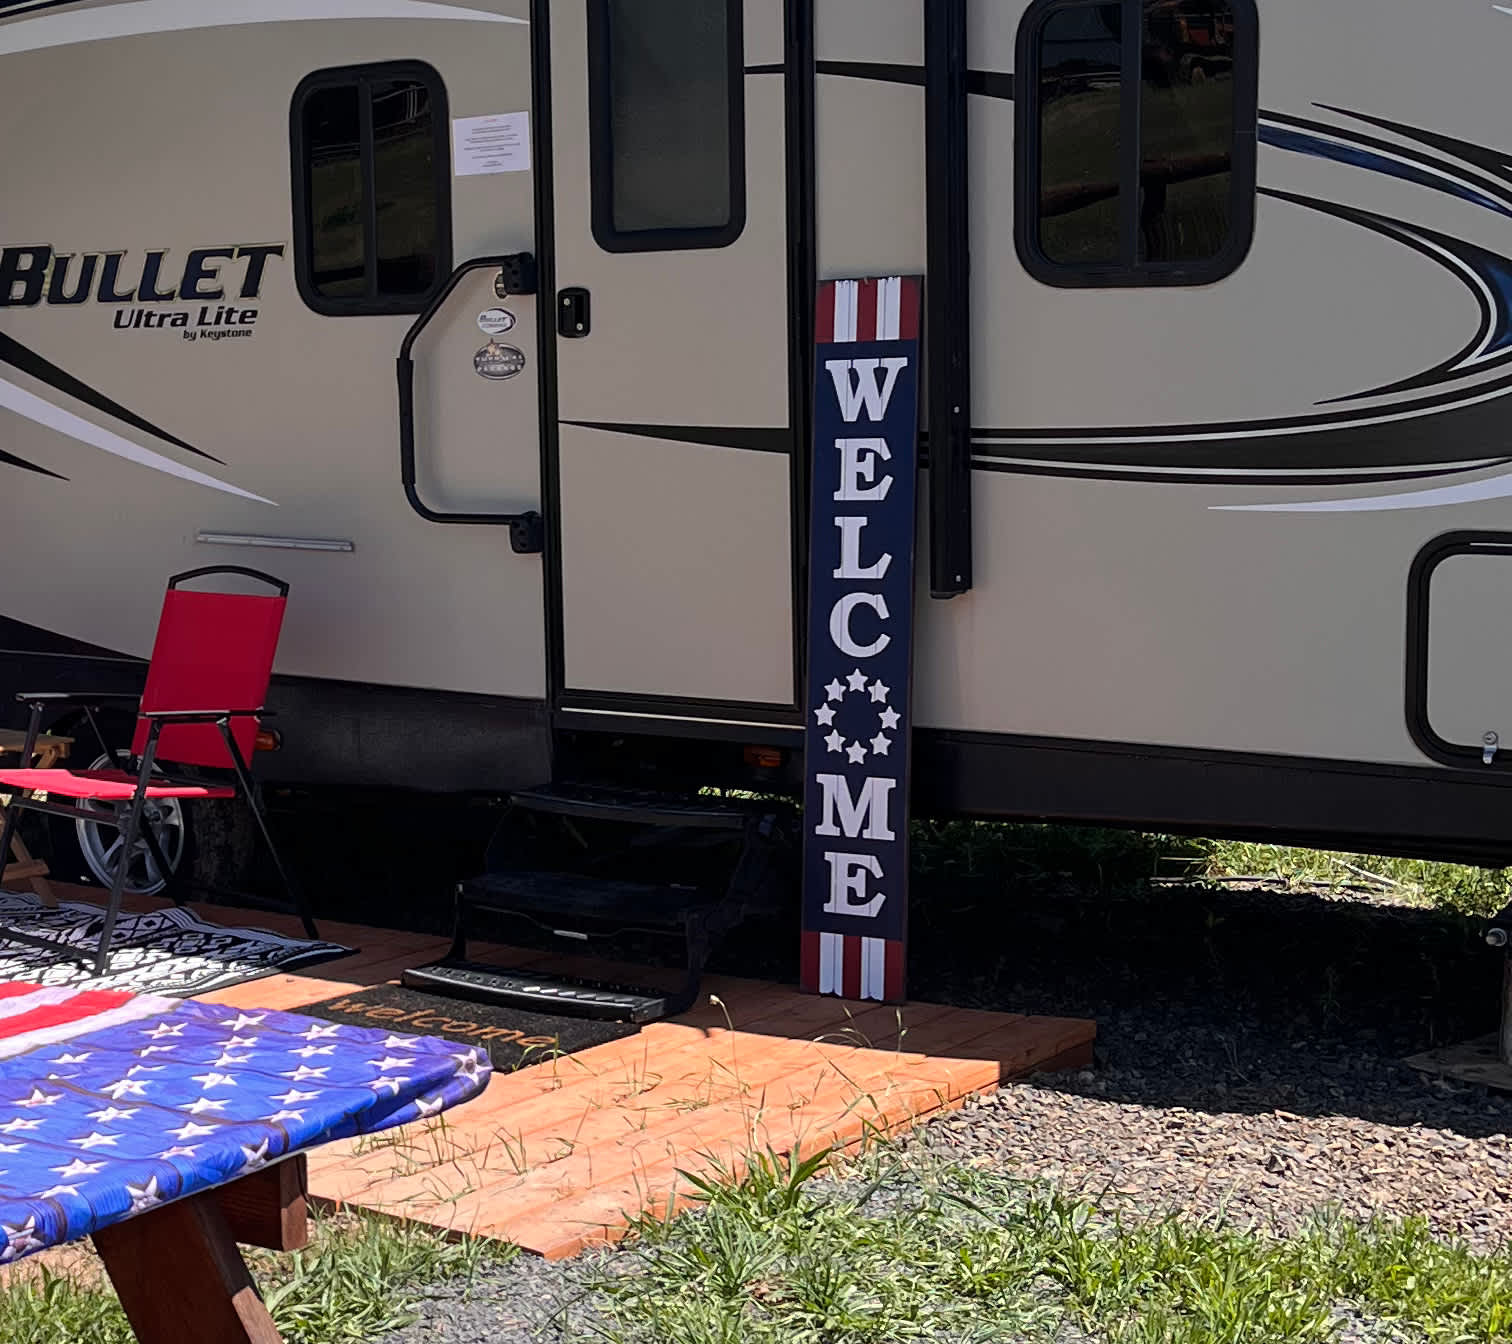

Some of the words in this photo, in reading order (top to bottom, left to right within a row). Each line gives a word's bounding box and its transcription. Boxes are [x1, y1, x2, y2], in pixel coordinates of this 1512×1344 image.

[113, 309, 189, 329] Ultra
[197, 306, 258, 327] Lite
[183, 329, 197, 341] by
[200, 329, 253, 341] Keystone
[328, 999, 557, 1047] welcome
